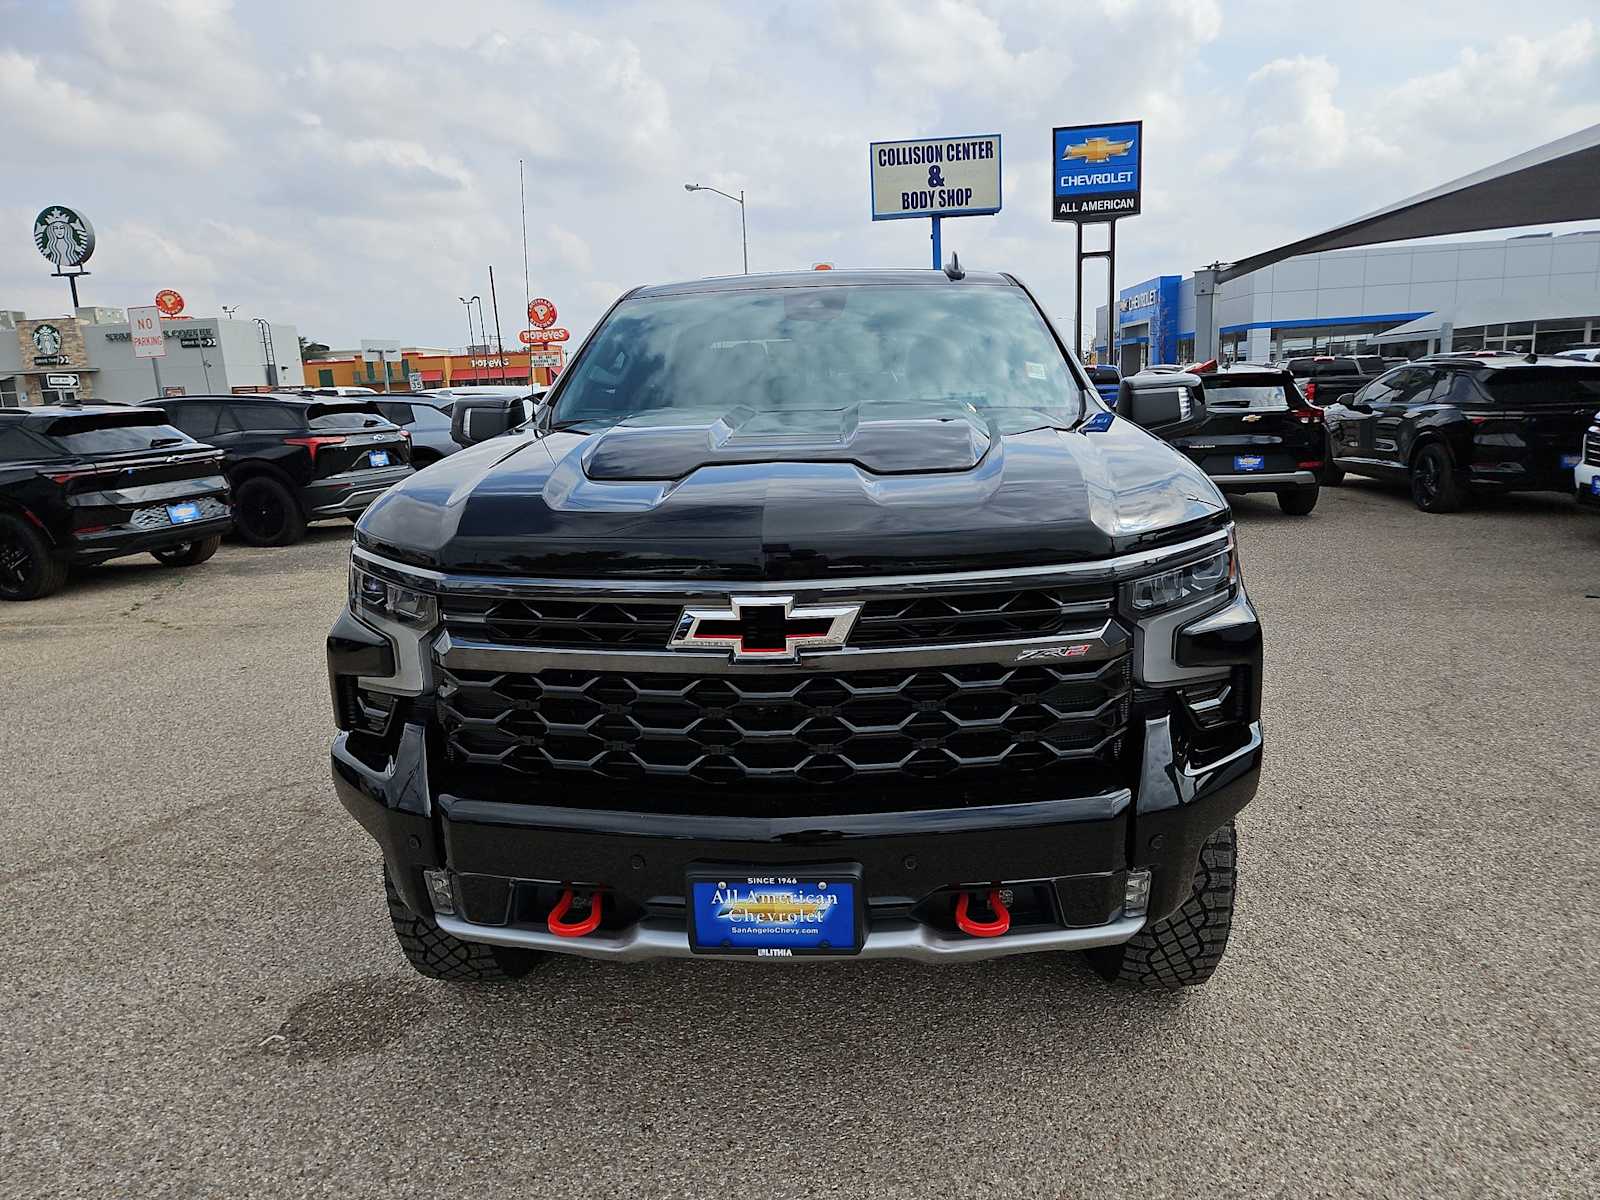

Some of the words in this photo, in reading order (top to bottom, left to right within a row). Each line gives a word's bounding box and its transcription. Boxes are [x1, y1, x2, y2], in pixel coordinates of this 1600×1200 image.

[878, 144, 944, 167] COLLISION
[946, 140, 994, 161] CENTER
[928, 165, 945, 188] &
[1061, 171, 1133, 187] CHEVROLET
[901, 190, 935, 210] BODY
[938, 188, 972, 207] SHOP
[1059, 201, 1079, 214] ALL
[1081, 198, 1134, 212] AMERICAN
[137, 318, 153, 330] NO
[133, 336, 163, 348] PARKING
[523, 329, 565, 341] POPEYES
[411, 381, 422, 389] 35
[1014, 644, 1092, 661] ZR2
[711, 889, 737, 904] All
[747, 890, 838, 905] American
[728, 909, 824, 923] Chevrolet
[731, 926, 819, 935] SanAngeloChevy.com
